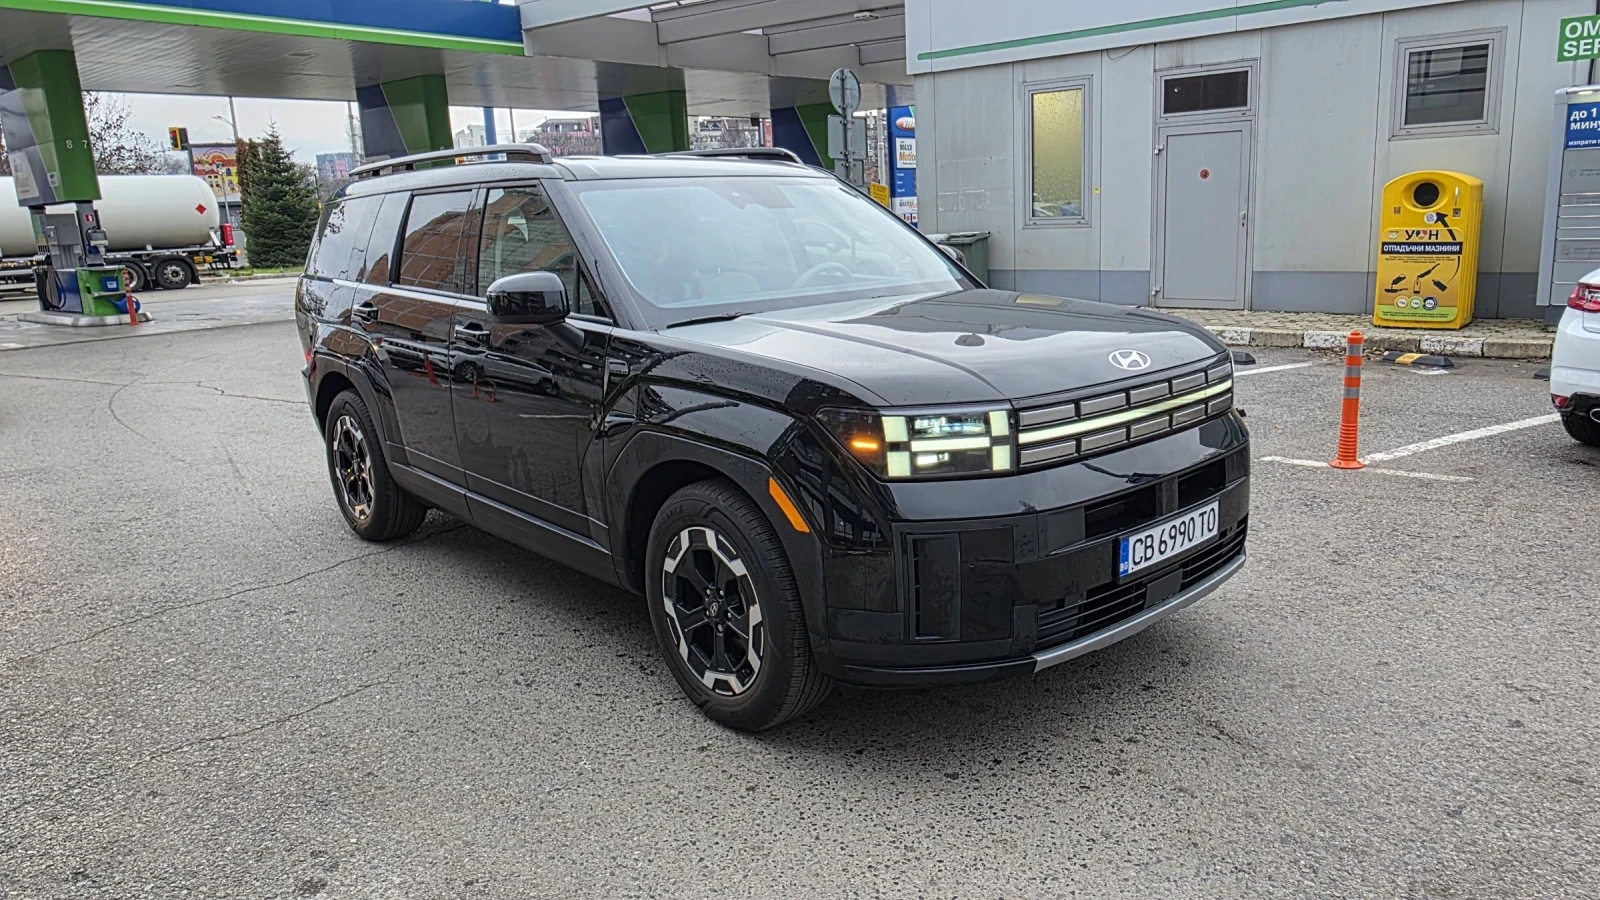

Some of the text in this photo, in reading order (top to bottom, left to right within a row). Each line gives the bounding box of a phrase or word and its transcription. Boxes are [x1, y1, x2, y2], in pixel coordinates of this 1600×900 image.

[1570, 110, 1587, 122] до
[66, 140, 88, 149] 8 7
[1132, 507, 1216, 566] CB 6990 TO
